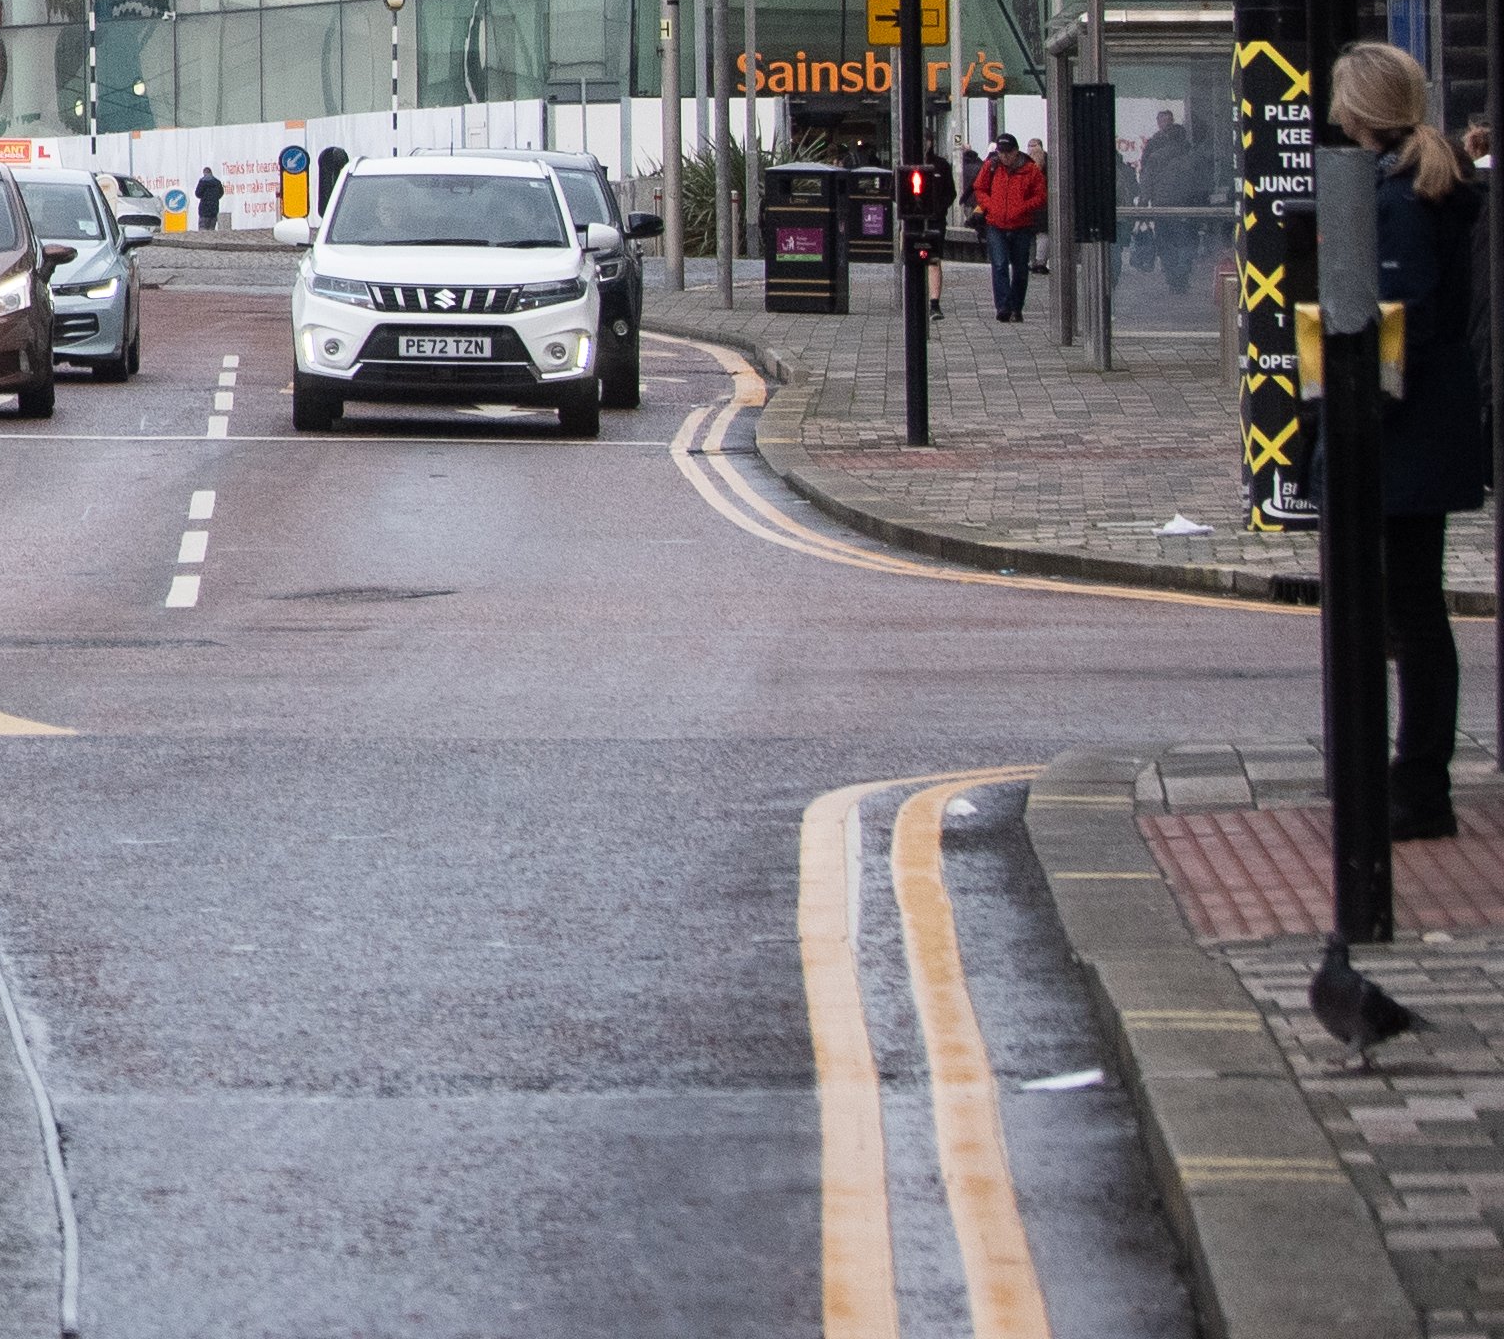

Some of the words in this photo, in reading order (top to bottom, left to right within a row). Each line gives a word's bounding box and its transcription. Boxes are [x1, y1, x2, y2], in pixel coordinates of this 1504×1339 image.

[1264, 105, 1312, 121] PLEA
[1277, 129, 1312, 145] KEE
[38, 146, 50, 158] L
[222, 162, 245, 175] Thanks
[246, 160, 254, 174] for
[1278, 152, 1312, 169] THI
[1254, 176, 1313, 192] JUNCT
[406, 339, 448, 354] PE72
[453, 339, 484, 354] TZN
